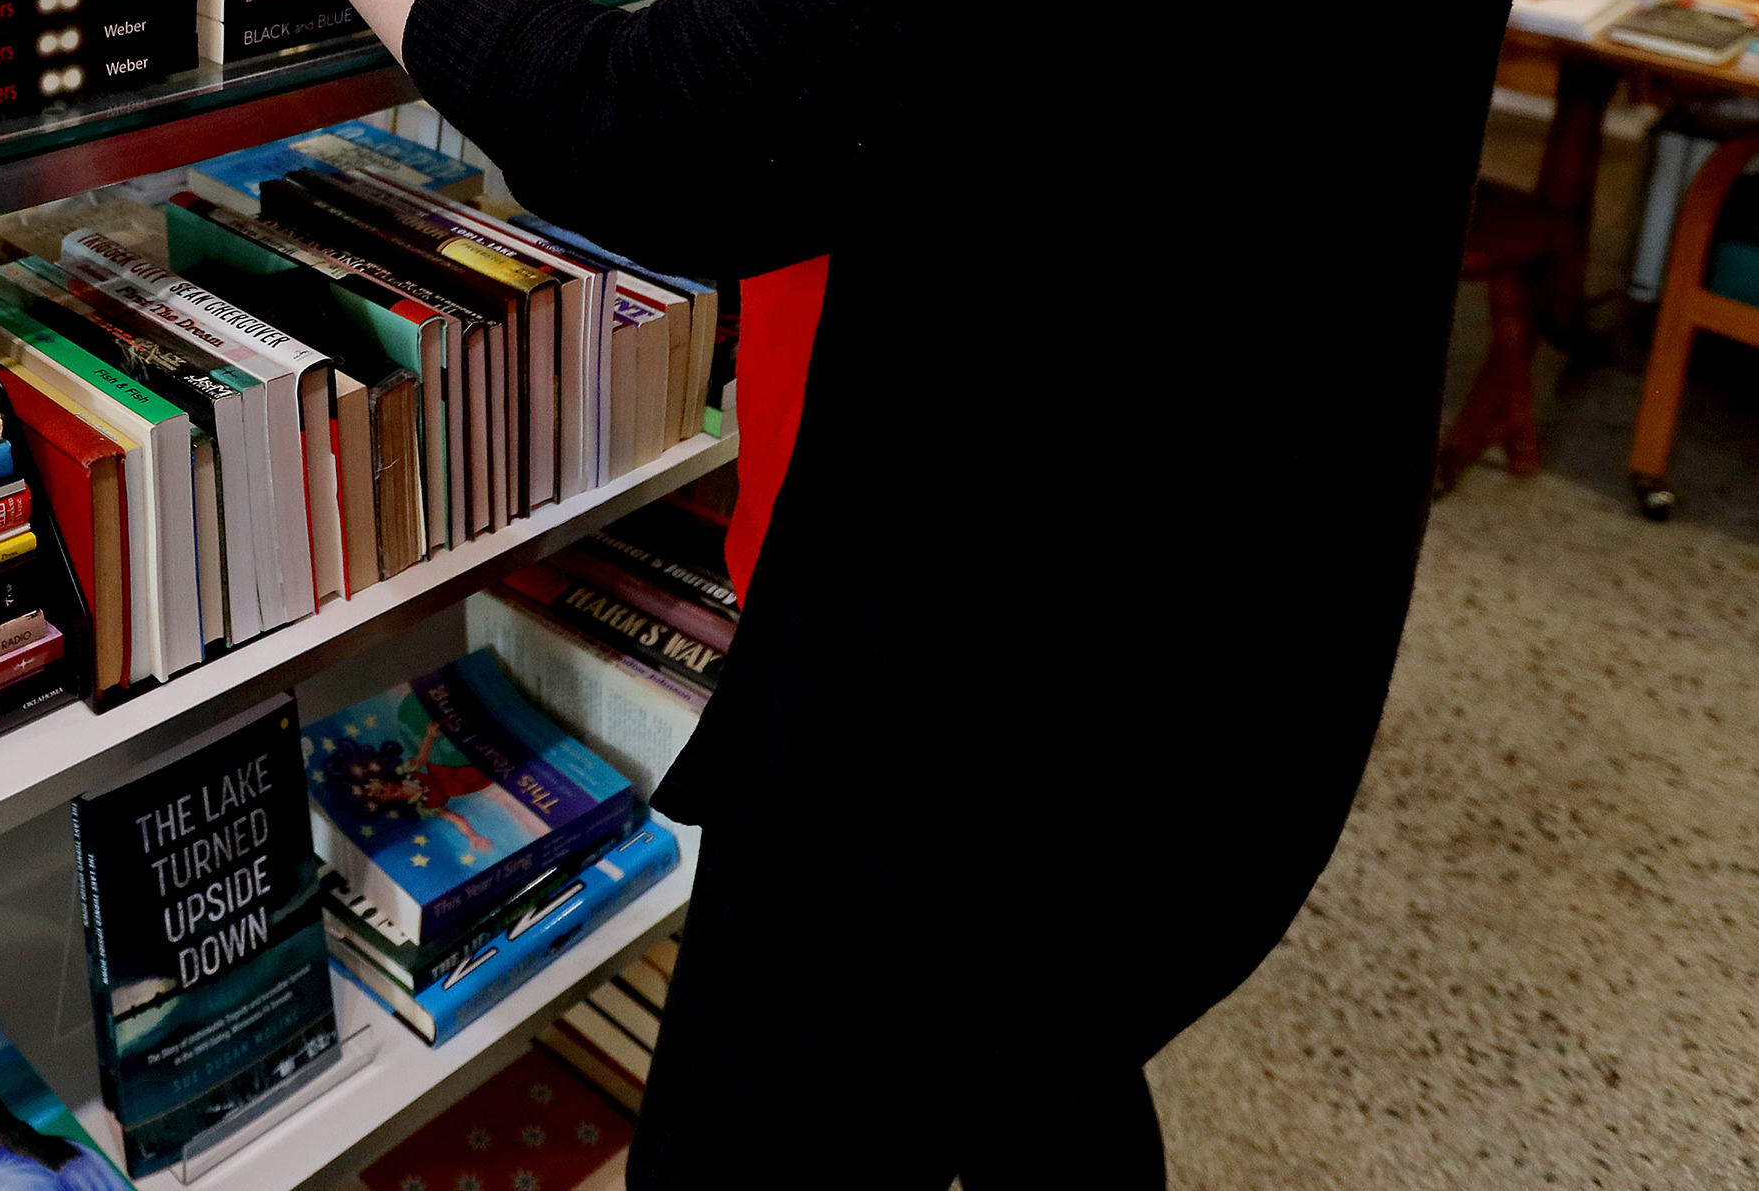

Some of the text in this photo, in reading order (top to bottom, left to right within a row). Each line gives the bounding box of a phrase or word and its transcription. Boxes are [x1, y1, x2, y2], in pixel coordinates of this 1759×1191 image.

[169, 281, 291, 349] SEAN CHERCOVER
[94, 368, 149, 404] Fish & Fish
[662, 628, 721, 675] WAY
[136, 752, 272, 853] THE LAKE
[151, 806, 269, 896] TURNED
[163, 855, 271, 943] UPSIDE
[178, 905, 270, 989] DOWN
